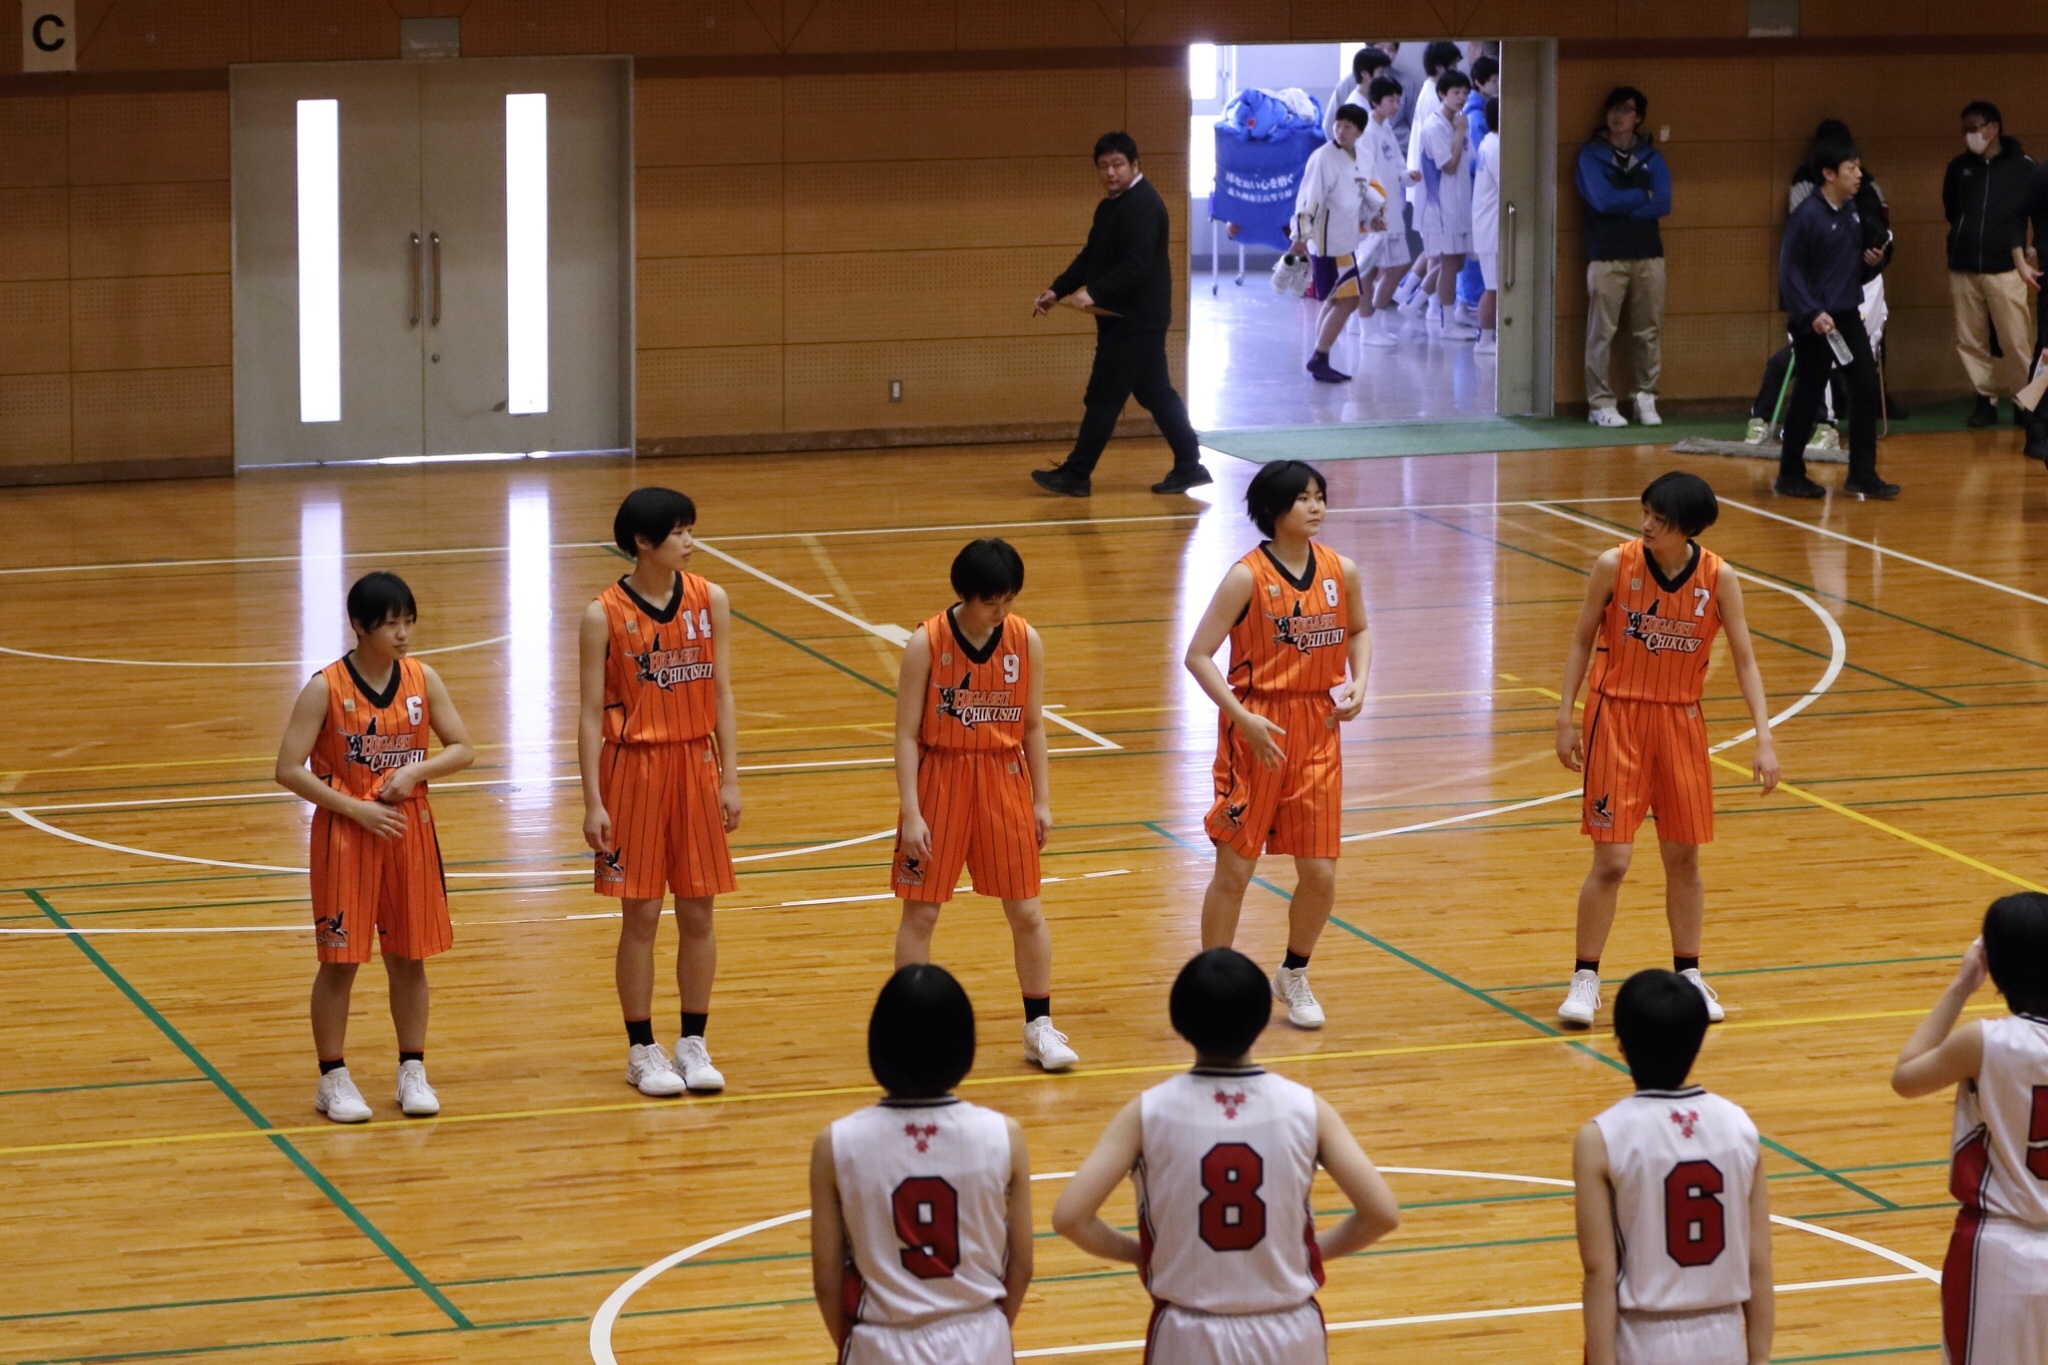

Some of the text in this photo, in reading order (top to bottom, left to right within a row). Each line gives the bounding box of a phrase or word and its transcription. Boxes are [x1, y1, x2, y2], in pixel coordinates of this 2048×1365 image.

[32, 14, 65, 52] C
[1322, 578, 1339, 609] 8
[1694, 586, 1711, 618] 7
[682, 608, 712, 641] 14
[1297, 628, 1345, 651] CHIKUHI
[1645, 633, 1703, 653] CHIKUSI
[1003, 653, 1020, 685] 9
[405, 694, 423, 726] 6
[961, 705, 1023, 726] CHIKUSHI
[1199, 1142, 1267, 1252] 8
[1664, 1158, 1726, 1268] 6
[891, 1175, 961, 1280] 9
